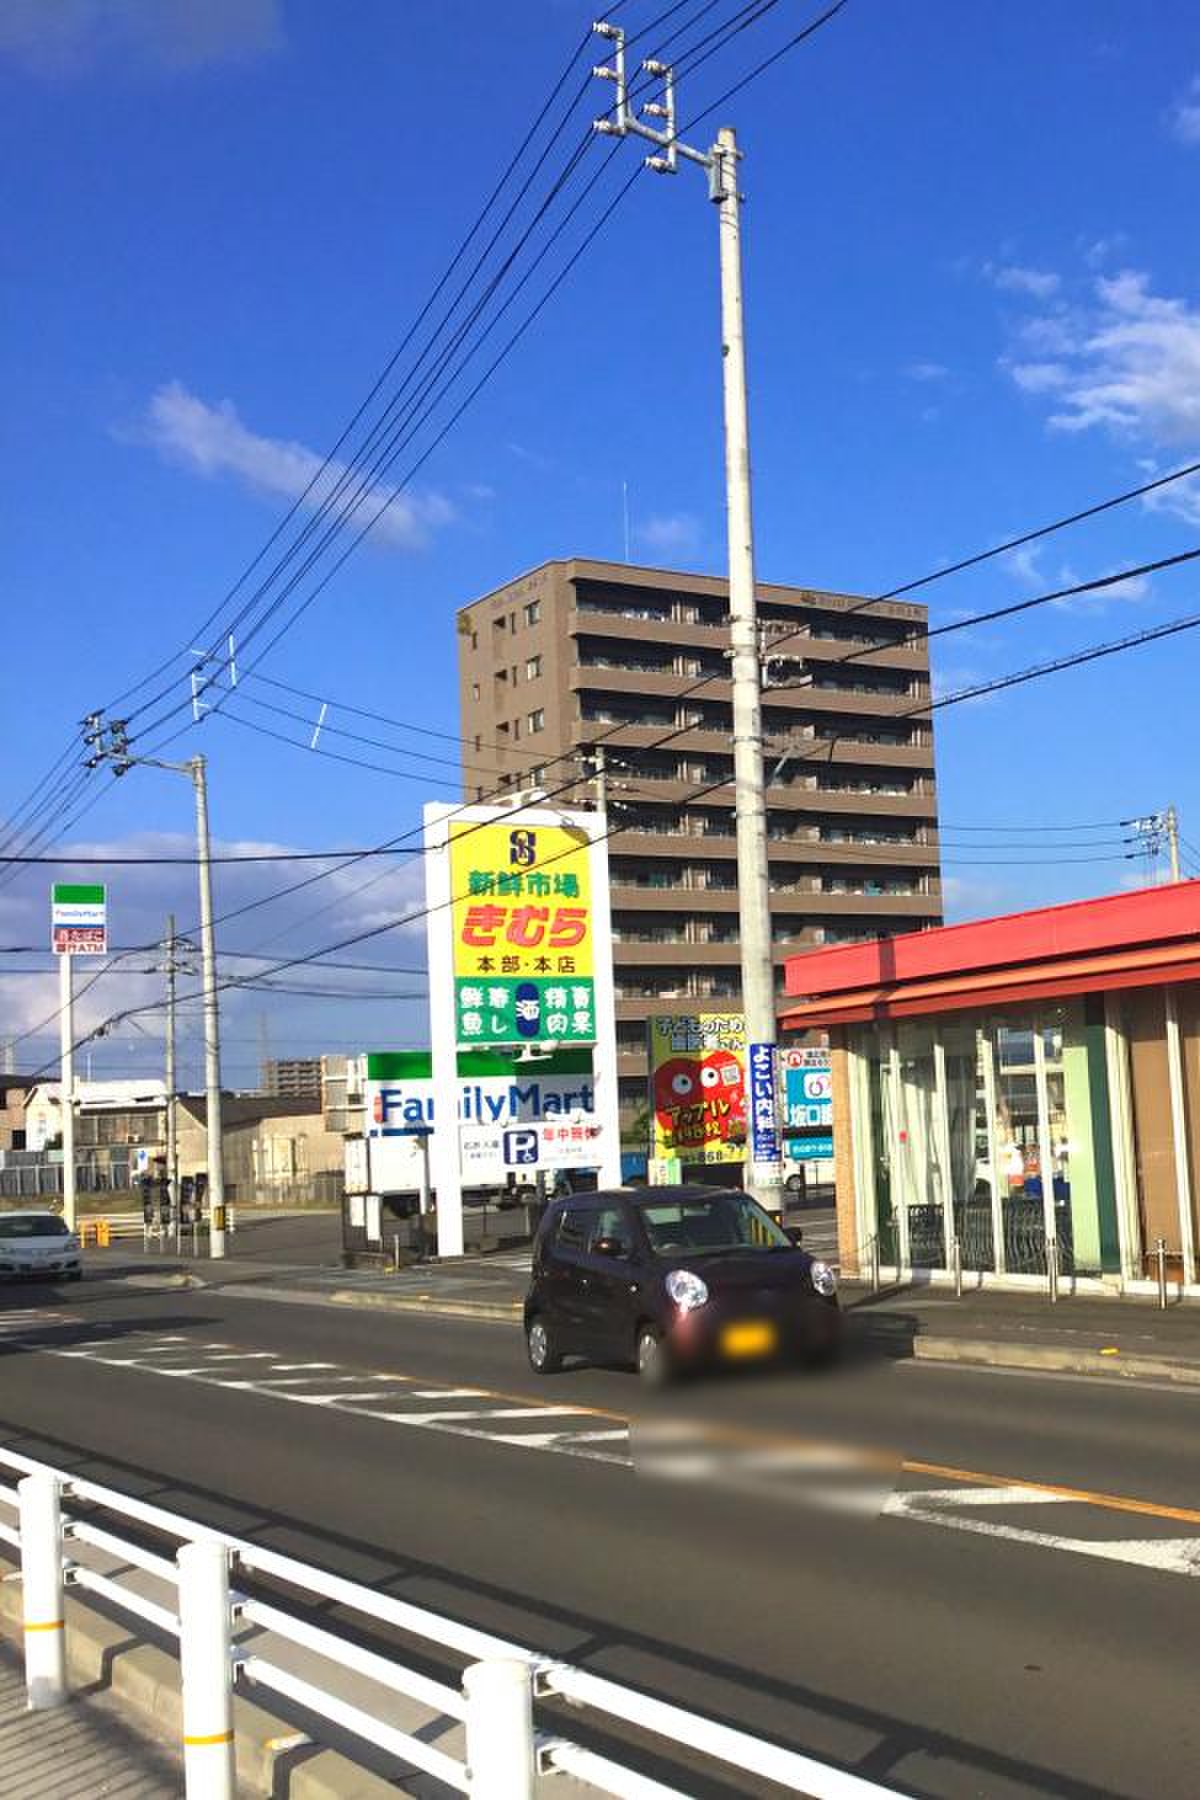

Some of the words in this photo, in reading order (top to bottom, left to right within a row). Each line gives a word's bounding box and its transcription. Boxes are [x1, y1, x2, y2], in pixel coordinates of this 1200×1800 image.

[469, 870, 579, 898] 新鮮市場
[462, 904, 588, 948] きむら
[753, 1046, 774, 1132] よこい内科
